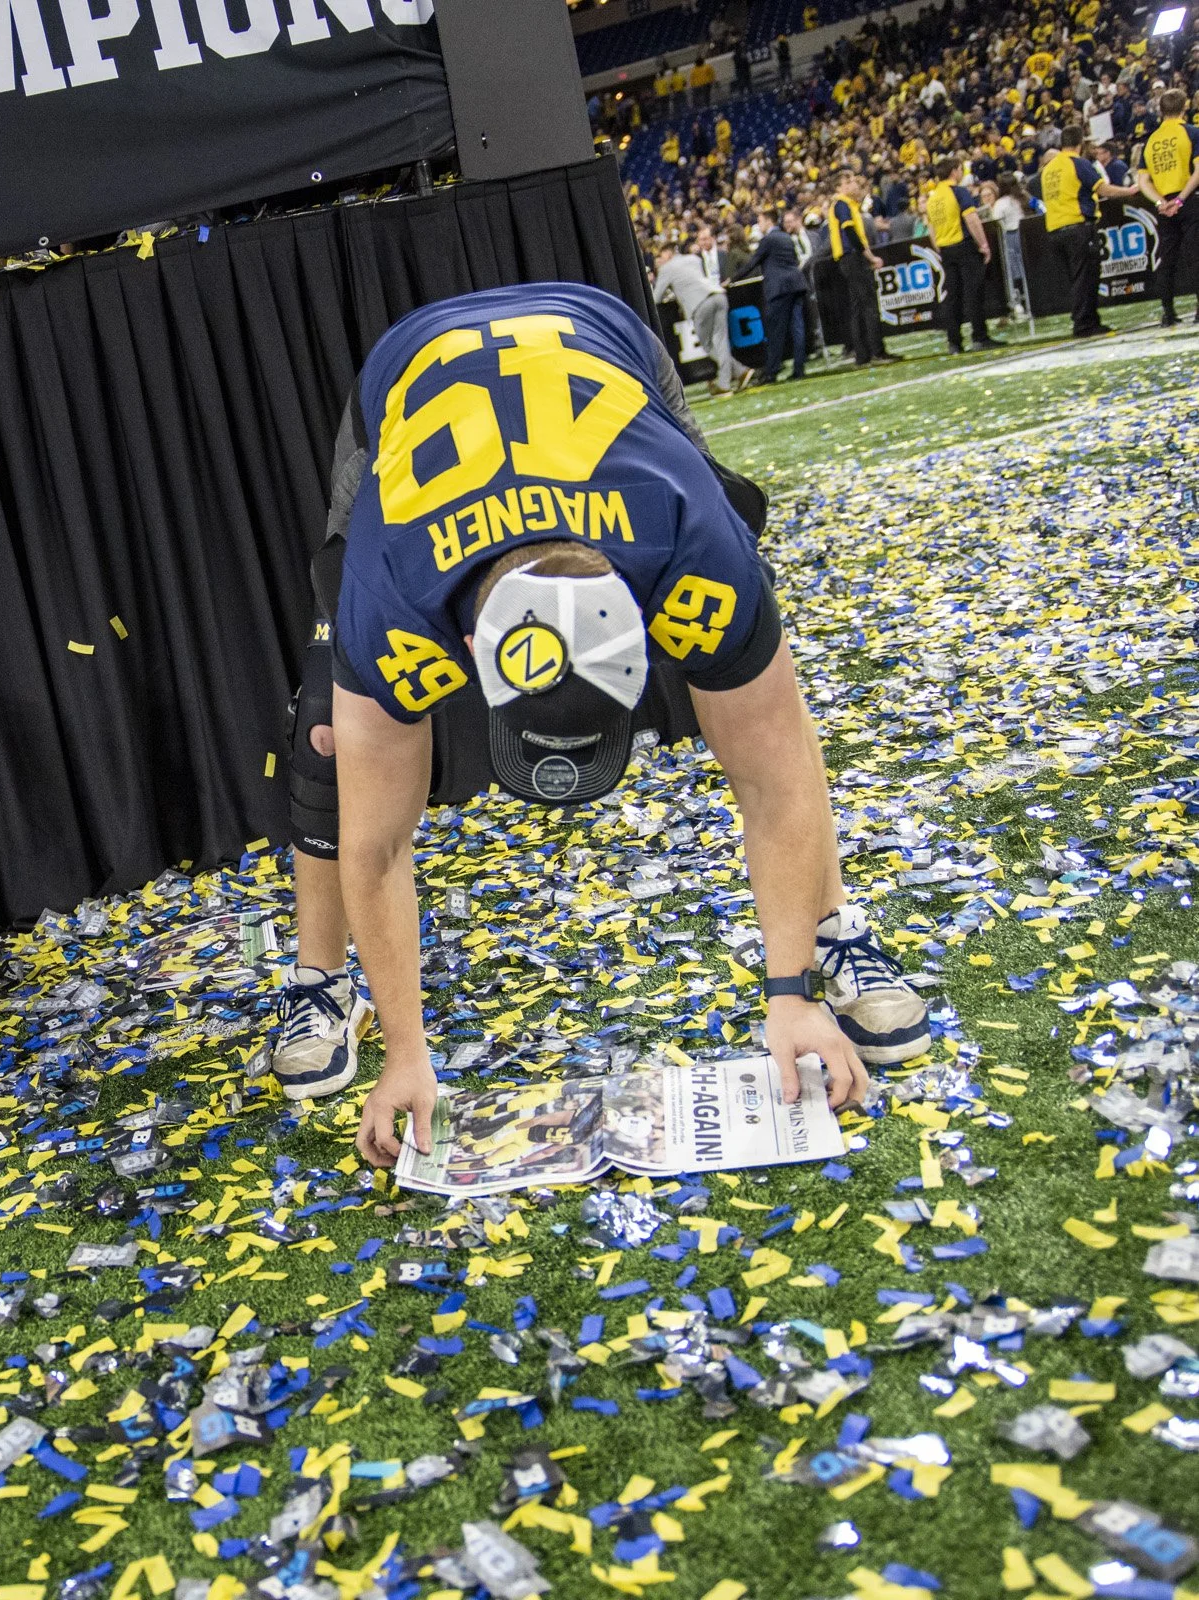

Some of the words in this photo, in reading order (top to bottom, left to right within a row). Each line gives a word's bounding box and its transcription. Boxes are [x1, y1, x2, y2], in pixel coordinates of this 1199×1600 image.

[1152, 137, 1178, 152] CSC
[1153, 161, 1178, 175] STAFF
[373, 314, 649, 525] 49
[427, 486, 635, 572] WAGNER
[647, 575, 737, 661] 49
[376, 628, 469, 712] 49
